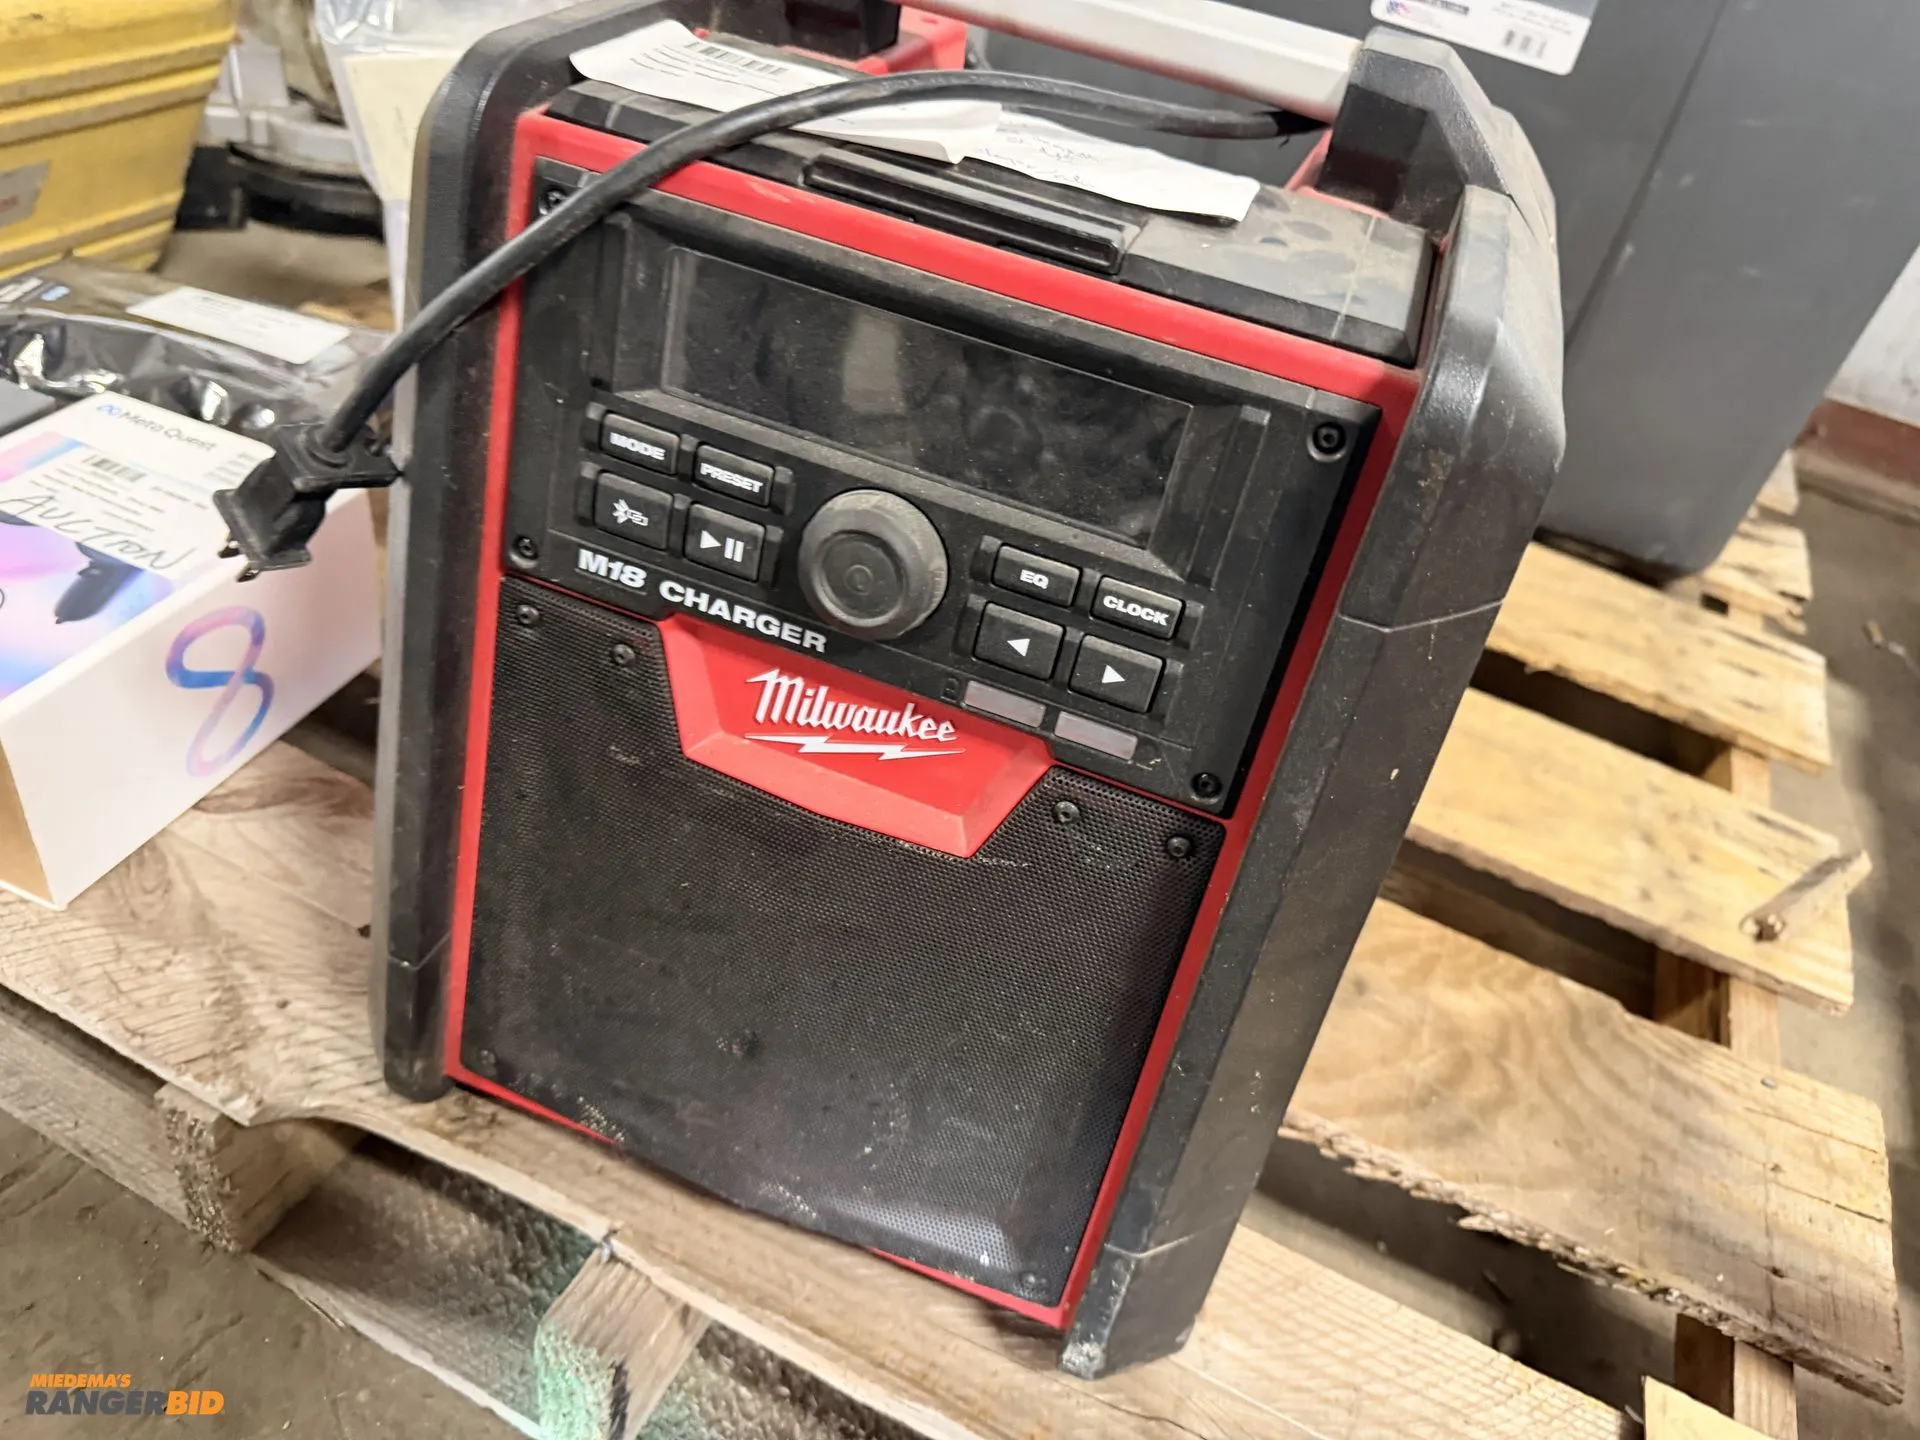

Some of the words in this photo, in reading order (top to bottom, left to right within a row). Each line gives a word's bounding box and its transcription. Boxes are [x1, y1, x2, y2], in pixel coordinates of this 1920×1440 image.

[118, 410, 165, 433] Meta
[163, 427, 217, 452] Quest
[609, 431, 666, 461] MODE
[699, 462, 764, 494] PRESET
[3, 494, 197, 571] AUCTION
[1019, 568, 1050, 590] EQ
[577, 548, 648, 589] M18
[658, 579, 828, 653] CHARGER
[1102, 594, 1170, 627] CLOCK
[744, 667, 958, 743] Milwaukee
